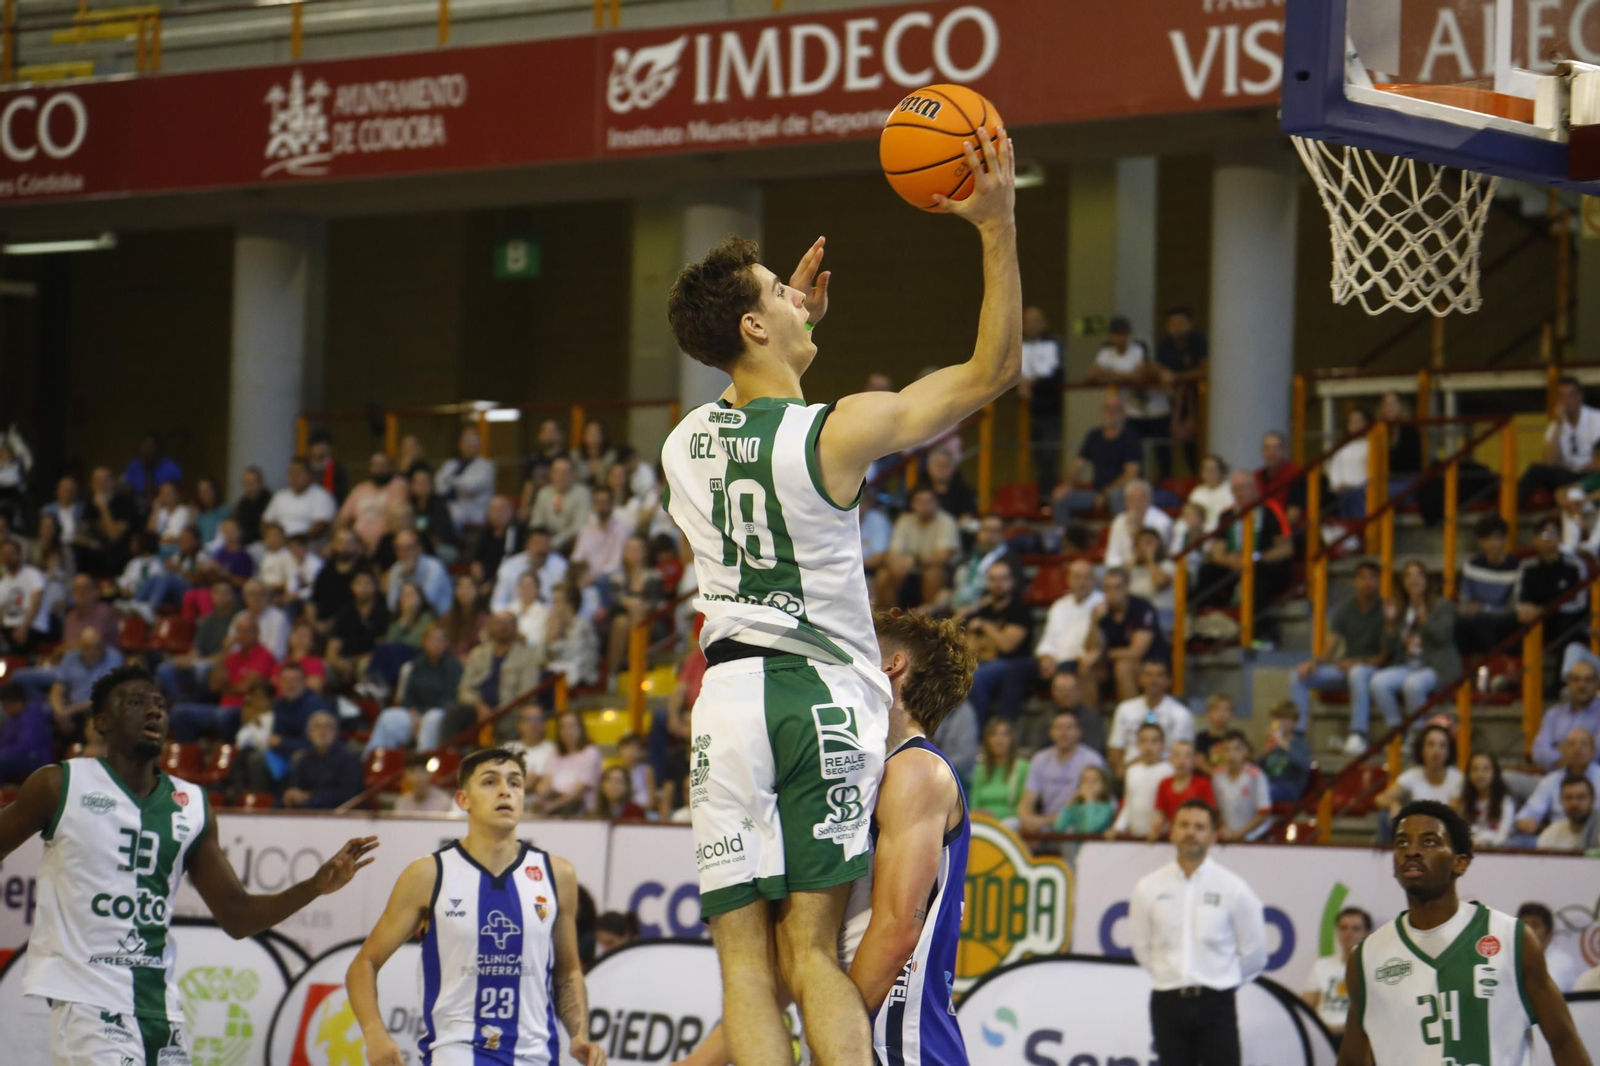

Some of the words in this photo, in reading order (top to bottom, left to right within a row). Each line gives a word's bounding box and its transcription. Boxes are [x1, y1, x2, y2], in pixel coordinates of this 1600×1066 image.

[694, 6, 1000, 104] IMDECO
[1167, 19, 1285, 101] VIS
[333, 73, 467, 114] AYUNTAMIENTO
[333, 121, 356, 154] DE
[607, 127, 684, 149] Instituto
[687, 119, 781, 143] Municipal
[781, 117, 809, 136] de
[690, 432, 717, 459] DEL
[825, 753, 866, 767] REALE
[825, 763, 865, 776] SEGUROS
[117, 827, 160, 876] 33
[91, 890, 166, 922] coto
[479, 987, 515, 1019] 23
[1417, 989, 1461, 1046] 24
